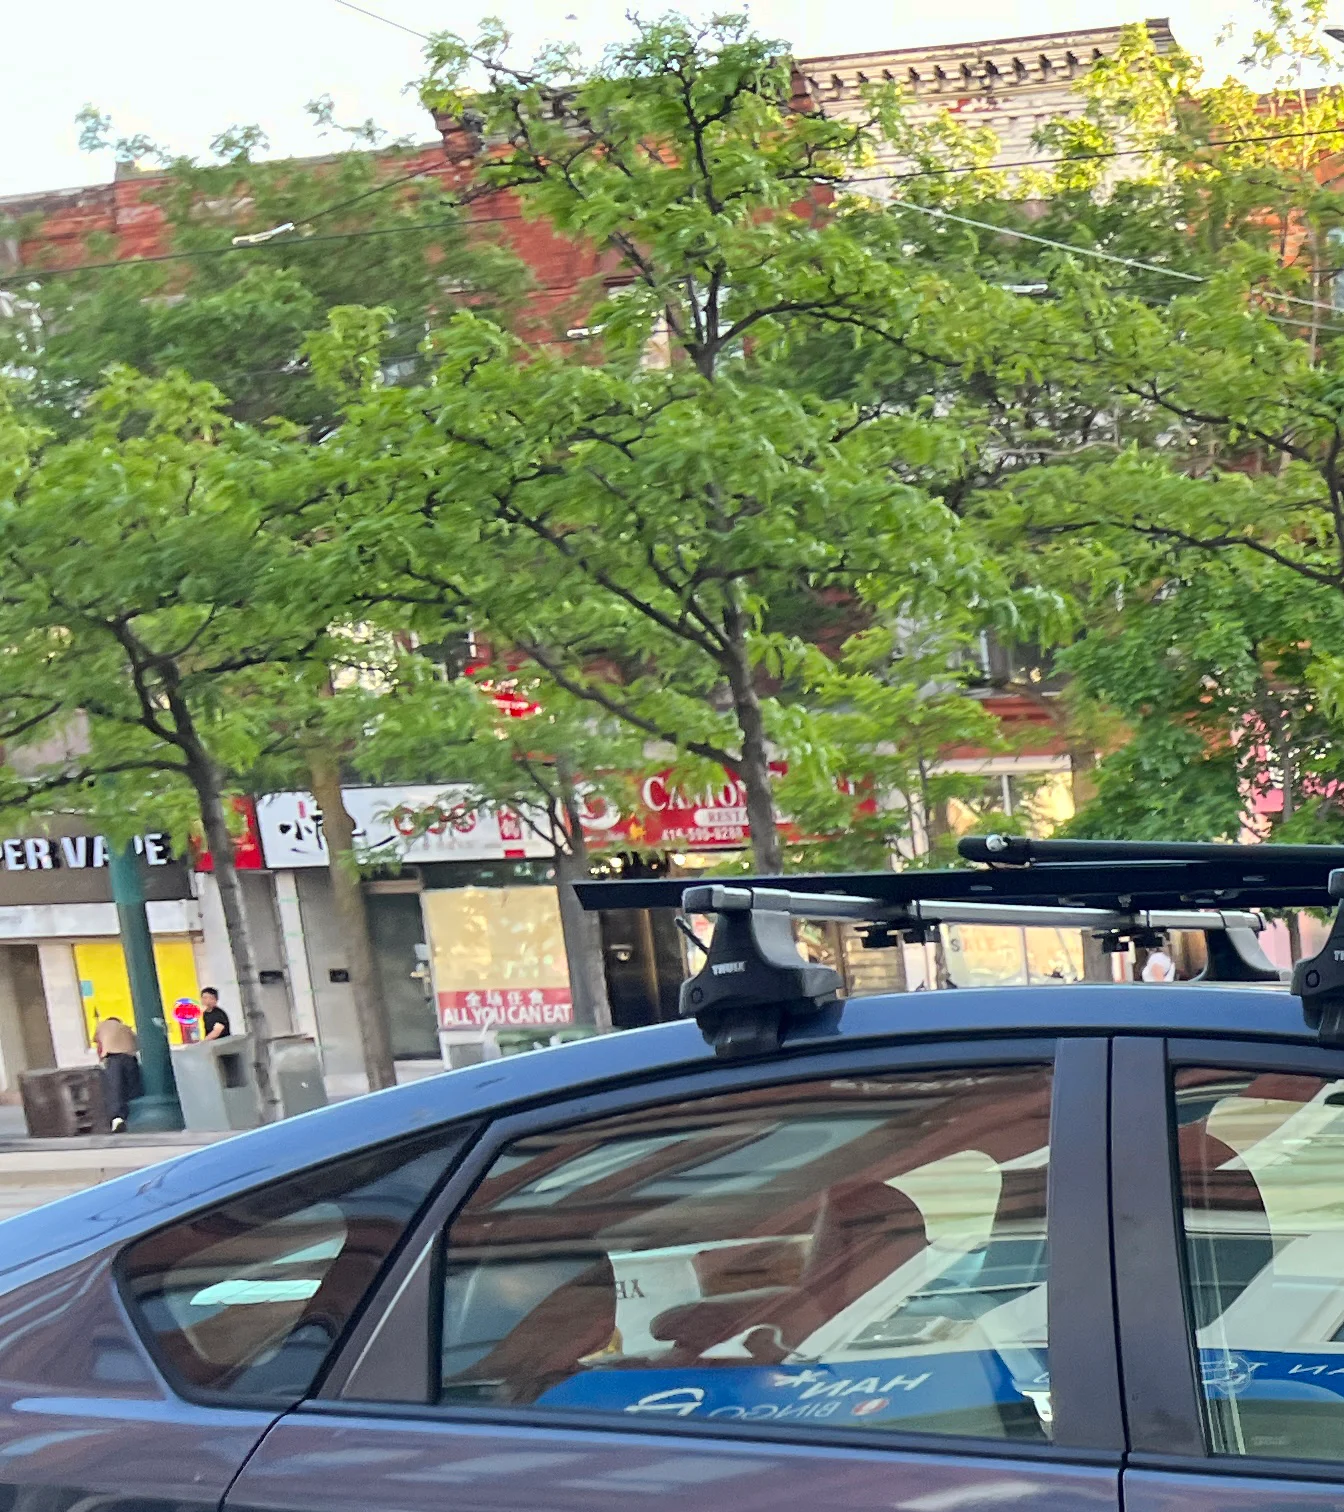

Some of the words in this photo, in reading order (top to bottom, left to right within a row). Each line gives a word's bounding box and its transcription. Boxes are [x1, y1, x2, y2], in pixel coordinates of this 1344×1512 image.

[443, 1008, 472, 1025] ALL
[472, 1006, 506, 1024] YOU
[507, 1005, 541, 1024] CAN
[543, 1003, 573, 1023] EAT
